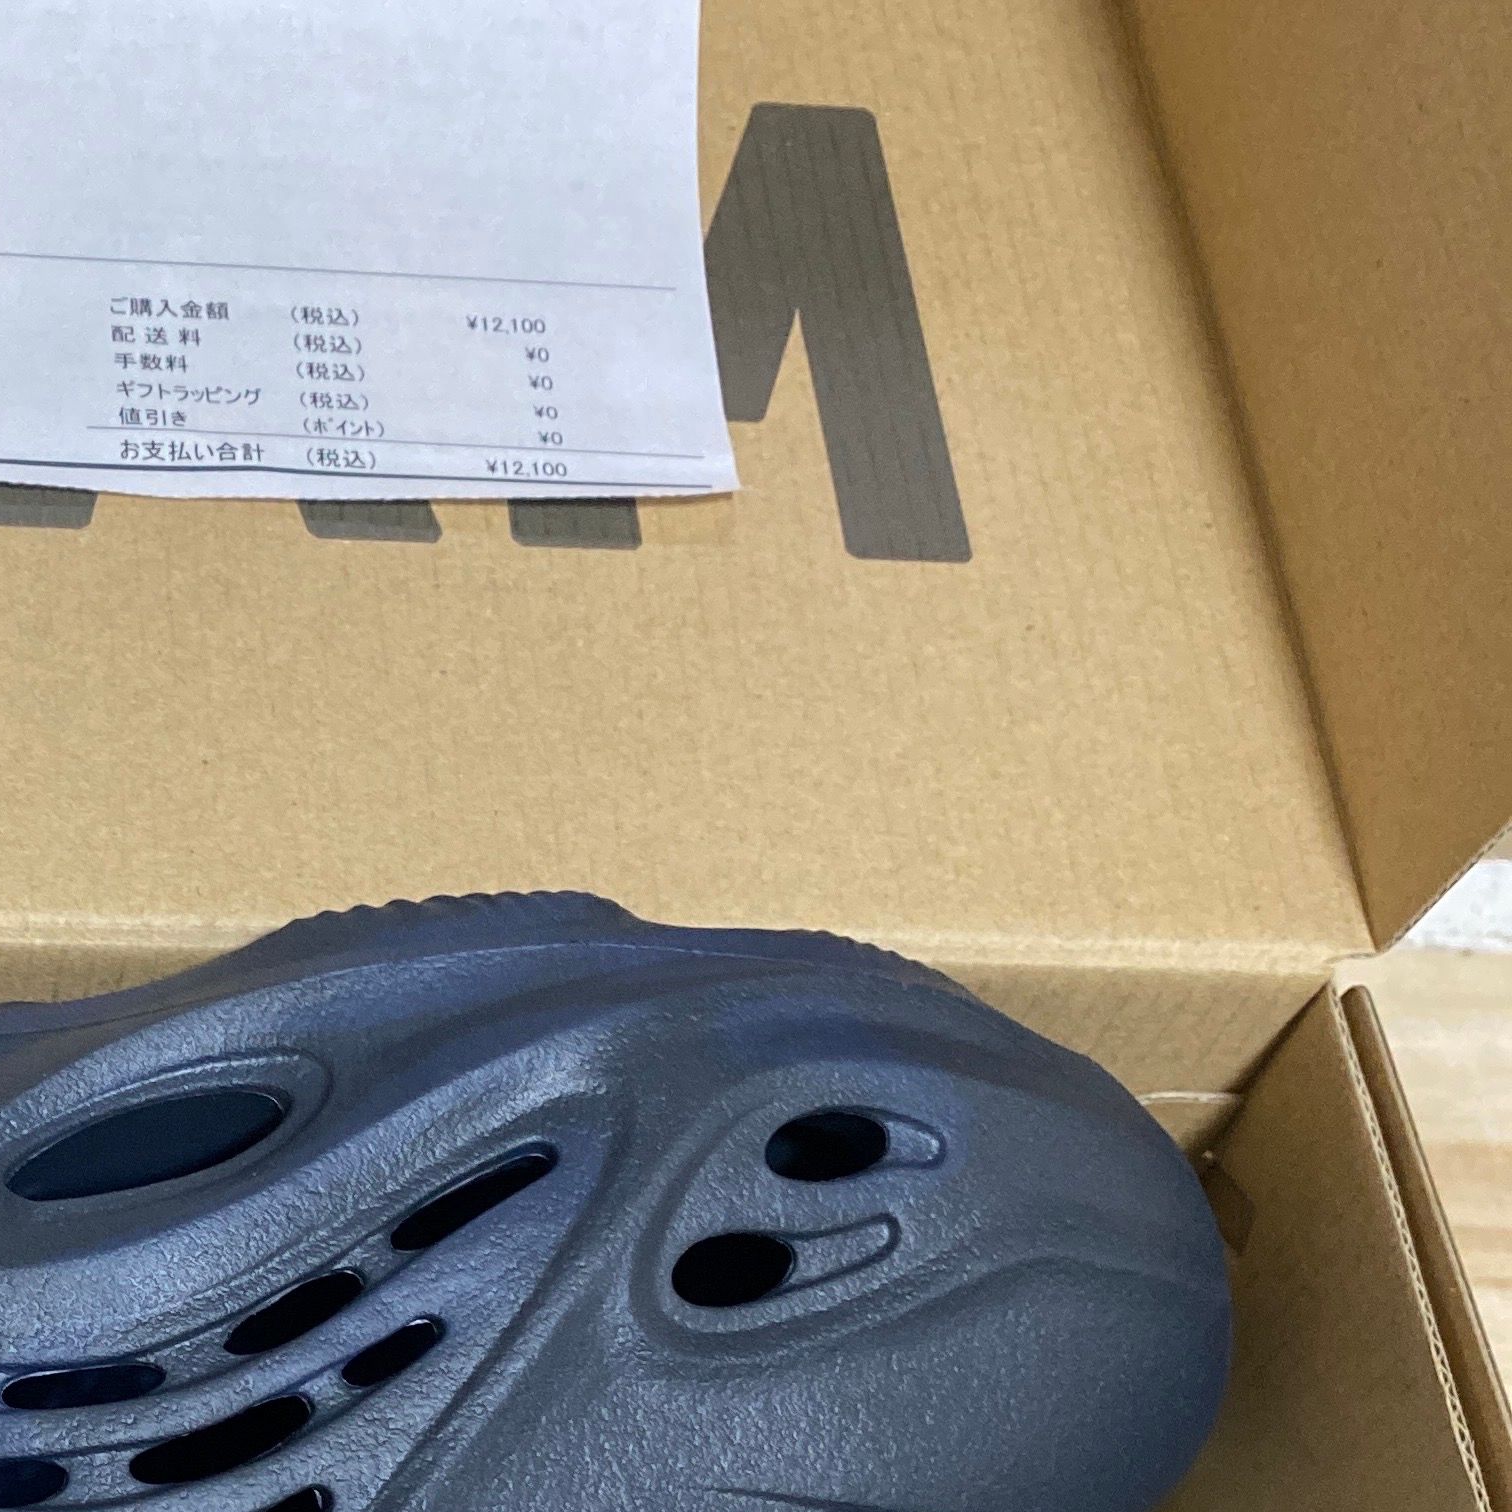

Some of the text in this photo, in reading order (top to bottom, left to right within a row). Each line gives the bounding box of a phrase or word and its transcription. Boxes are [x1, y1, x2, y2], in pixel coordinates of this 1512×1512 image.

[110, 297, 230, 321] ご購入金額
[466, 315, 546, 335] ¥12,100
[114, 353, 189, 373] 手数料
[528, 375, 553, 391] ¥0
[525, 347, 550, 362] ¥0
[116, 380, 261, 405] ギフトラッピング
[534, 405, 559, 420] ¥0
[119, 406, 187, 427] 値引き
[538, 431, 564, 446] ¥0
[120, 440, 265, 463] お支払い合計
[485, 459, 568, 478] ¥12,100
